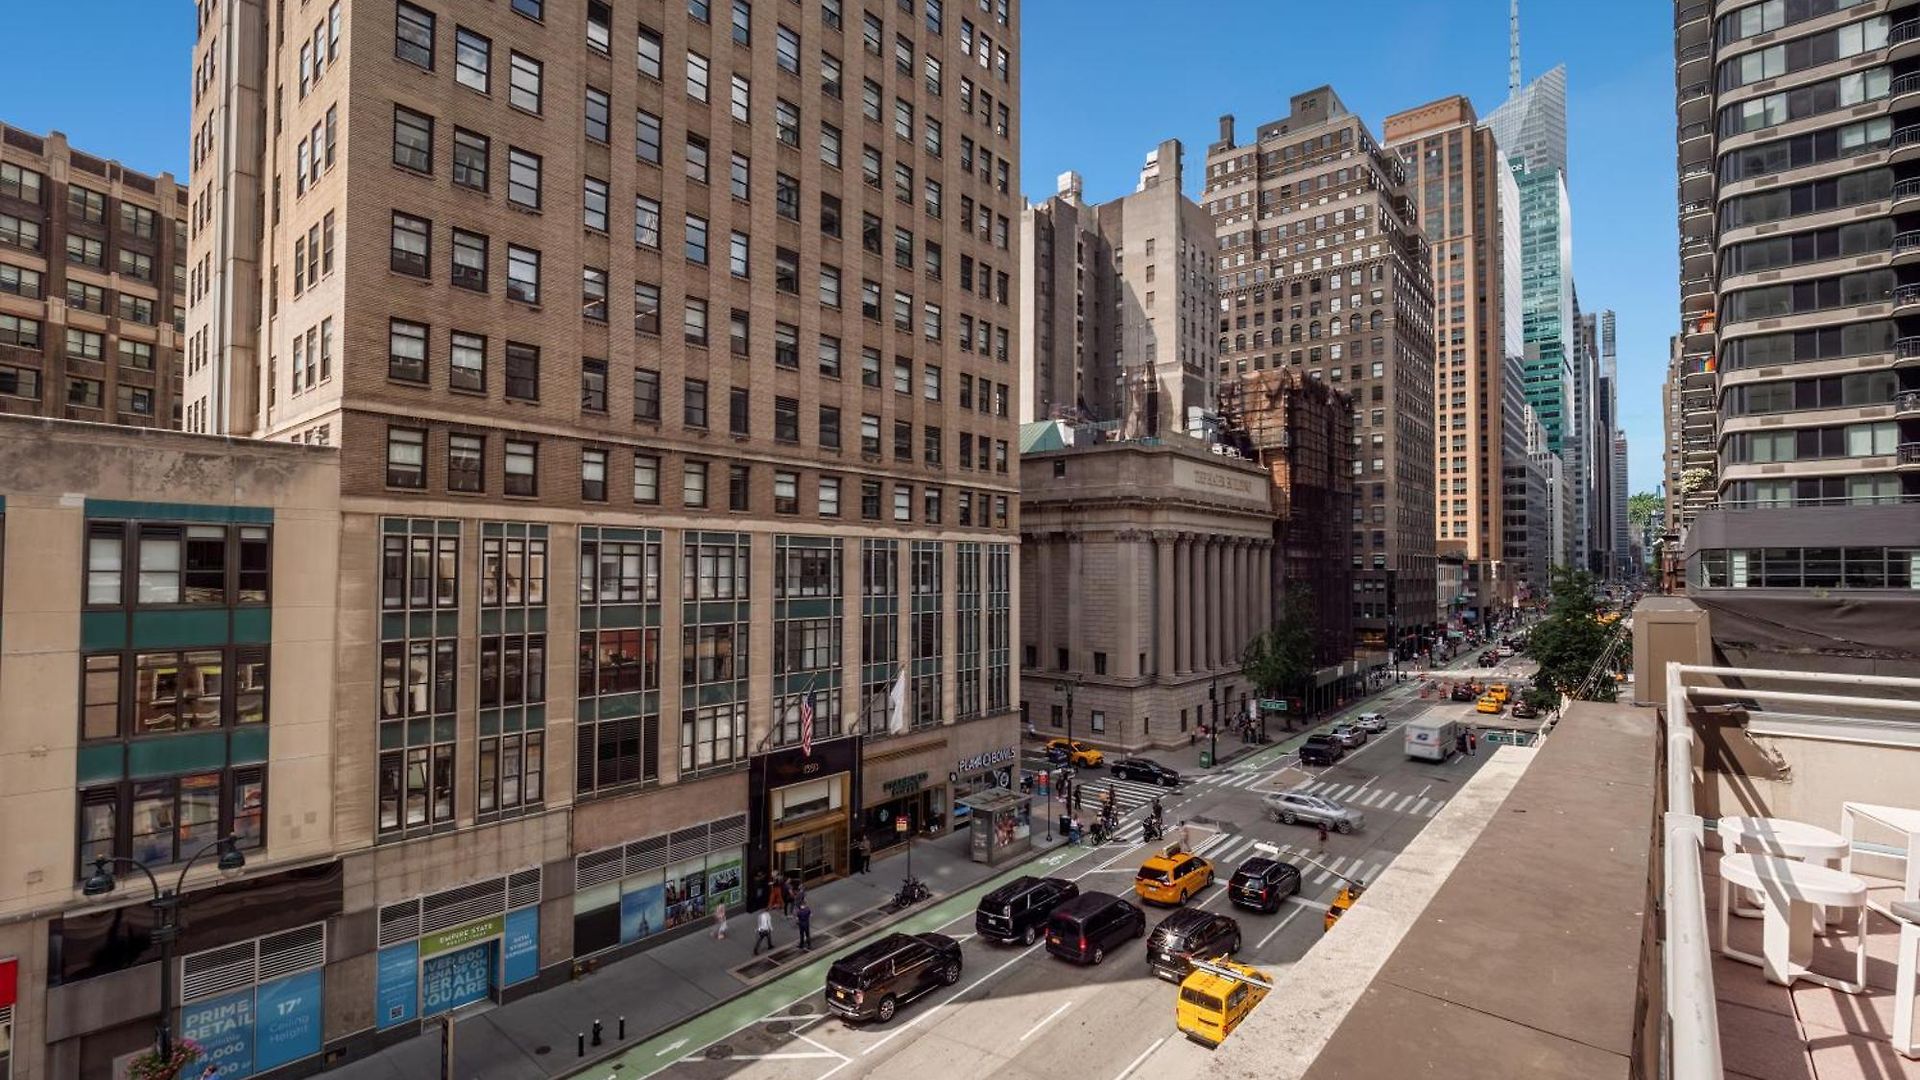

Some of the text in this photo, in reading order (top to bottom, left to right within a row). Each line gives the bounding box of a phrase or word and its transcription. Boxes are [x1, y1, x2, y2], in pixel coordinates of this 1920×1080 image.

[471, 922, 493, 936] STATE
[424, 979, 487, 1007] QUARE
[184, 1012, 254, 1041] RETAIL
[185, 999, 250, 1028] PRIME
